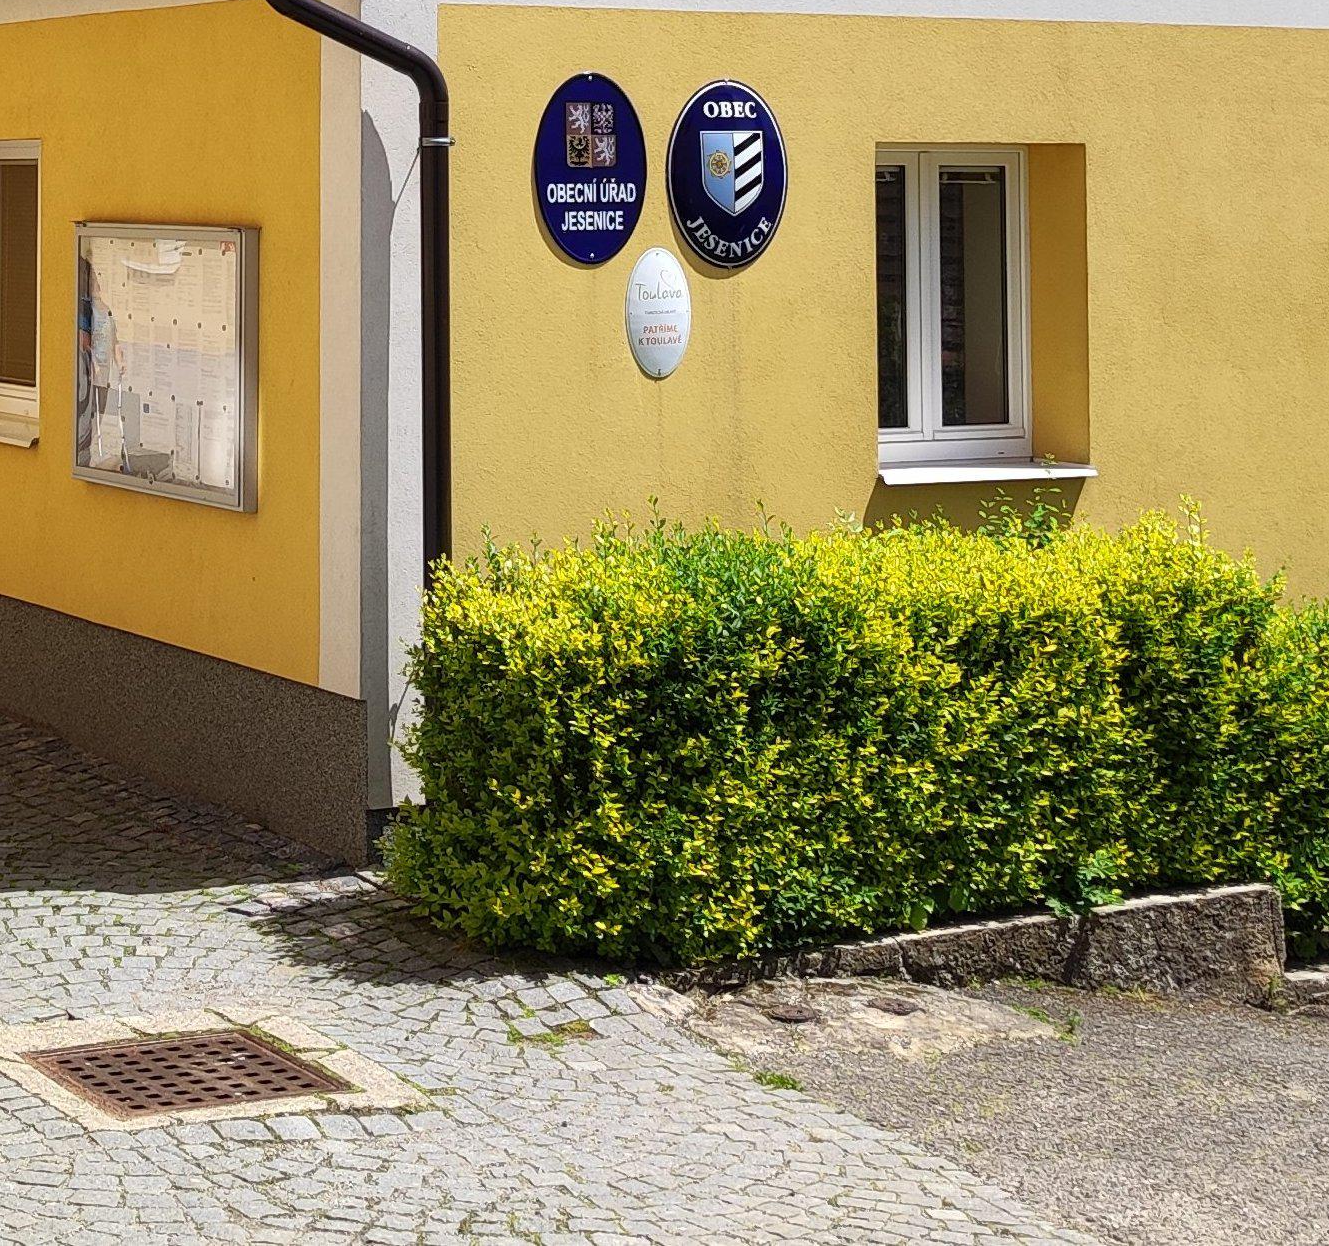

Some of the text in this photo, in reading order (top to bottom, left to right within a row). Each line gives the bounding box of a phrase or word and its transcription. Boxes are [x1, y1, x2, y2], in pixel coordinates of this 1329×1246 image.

[703, 102, 757, 118] OBEC
[547, 178, 637, 203] OBECNÍ ÚŘAD
[562, 211, 624, 231] JESENICE
[686, 216, 773, 258] JESENICE
